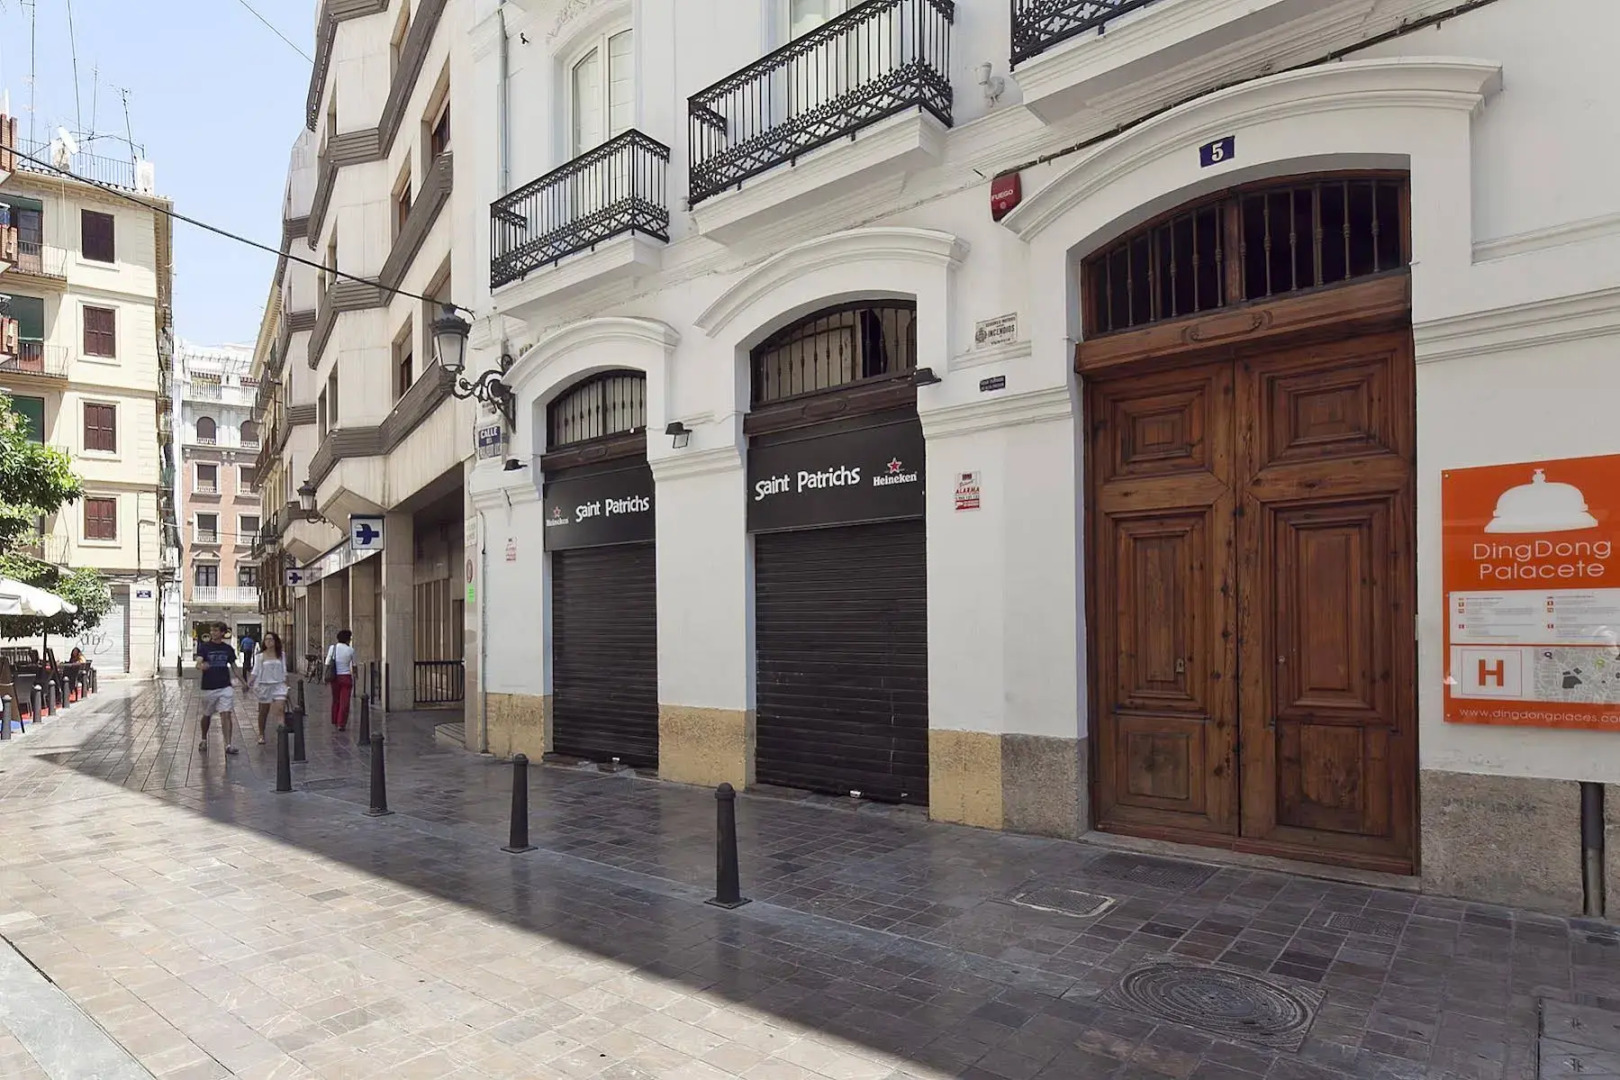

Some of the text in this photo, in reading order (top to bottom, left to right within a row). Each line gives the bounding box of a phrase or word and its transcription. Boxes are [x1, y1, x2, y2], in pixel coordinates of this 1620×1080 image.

[1211, 142, 1224, 162] 5
[991, 188, 1014, 201] FUEGO
[988, 324, 1015, 337] INCENDIOS
[480, 427, 498, 439] CALLE
[754, 465, 861, 501] Saint Patrichs
[873, 473, 917, 486] Heineken
[575, 495, 650, 522] Saint Patrichs
[1473, 540, 1612, 562] DingDong
[1480, 560, 1605, 580] Palacete
[1478, 659, 1504, 687] H
[1459, 707, 1620, 723] www.dingdongplaces.co
